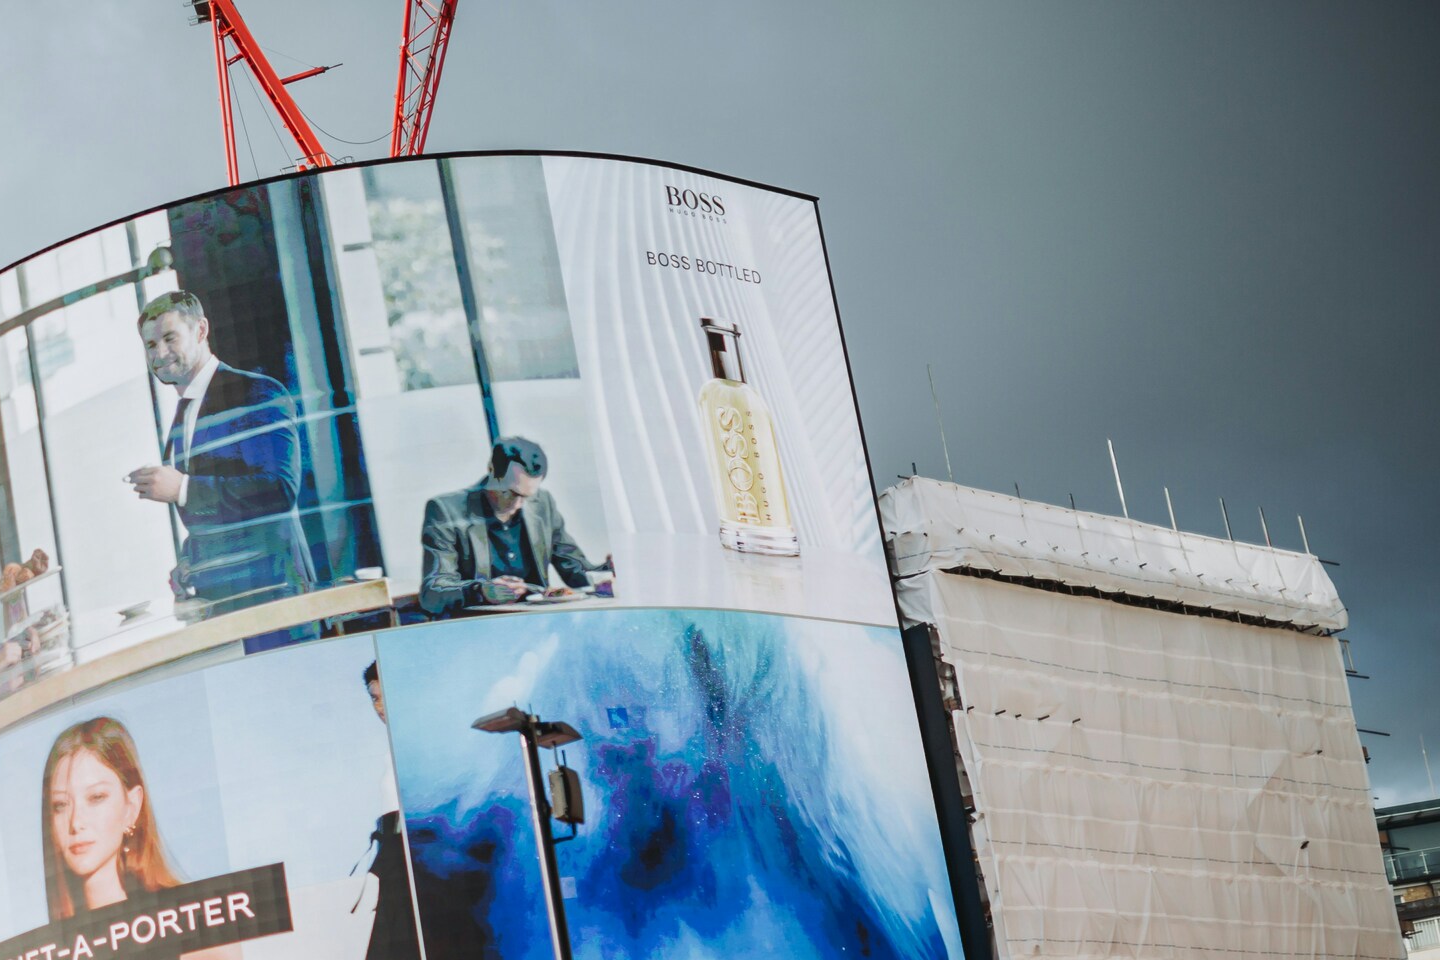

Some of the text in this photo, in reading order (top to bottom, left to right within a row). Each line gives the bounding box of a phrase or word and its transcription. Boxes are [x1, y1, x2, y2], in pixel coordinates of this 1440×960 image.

[665, 185, 726, 216] BOSS
[669, 207, 728, 225] HUGO BOSS
[646, 251, 762, 284] BOSS BOTTLED
[718, 406, 762, 523] BOSS
